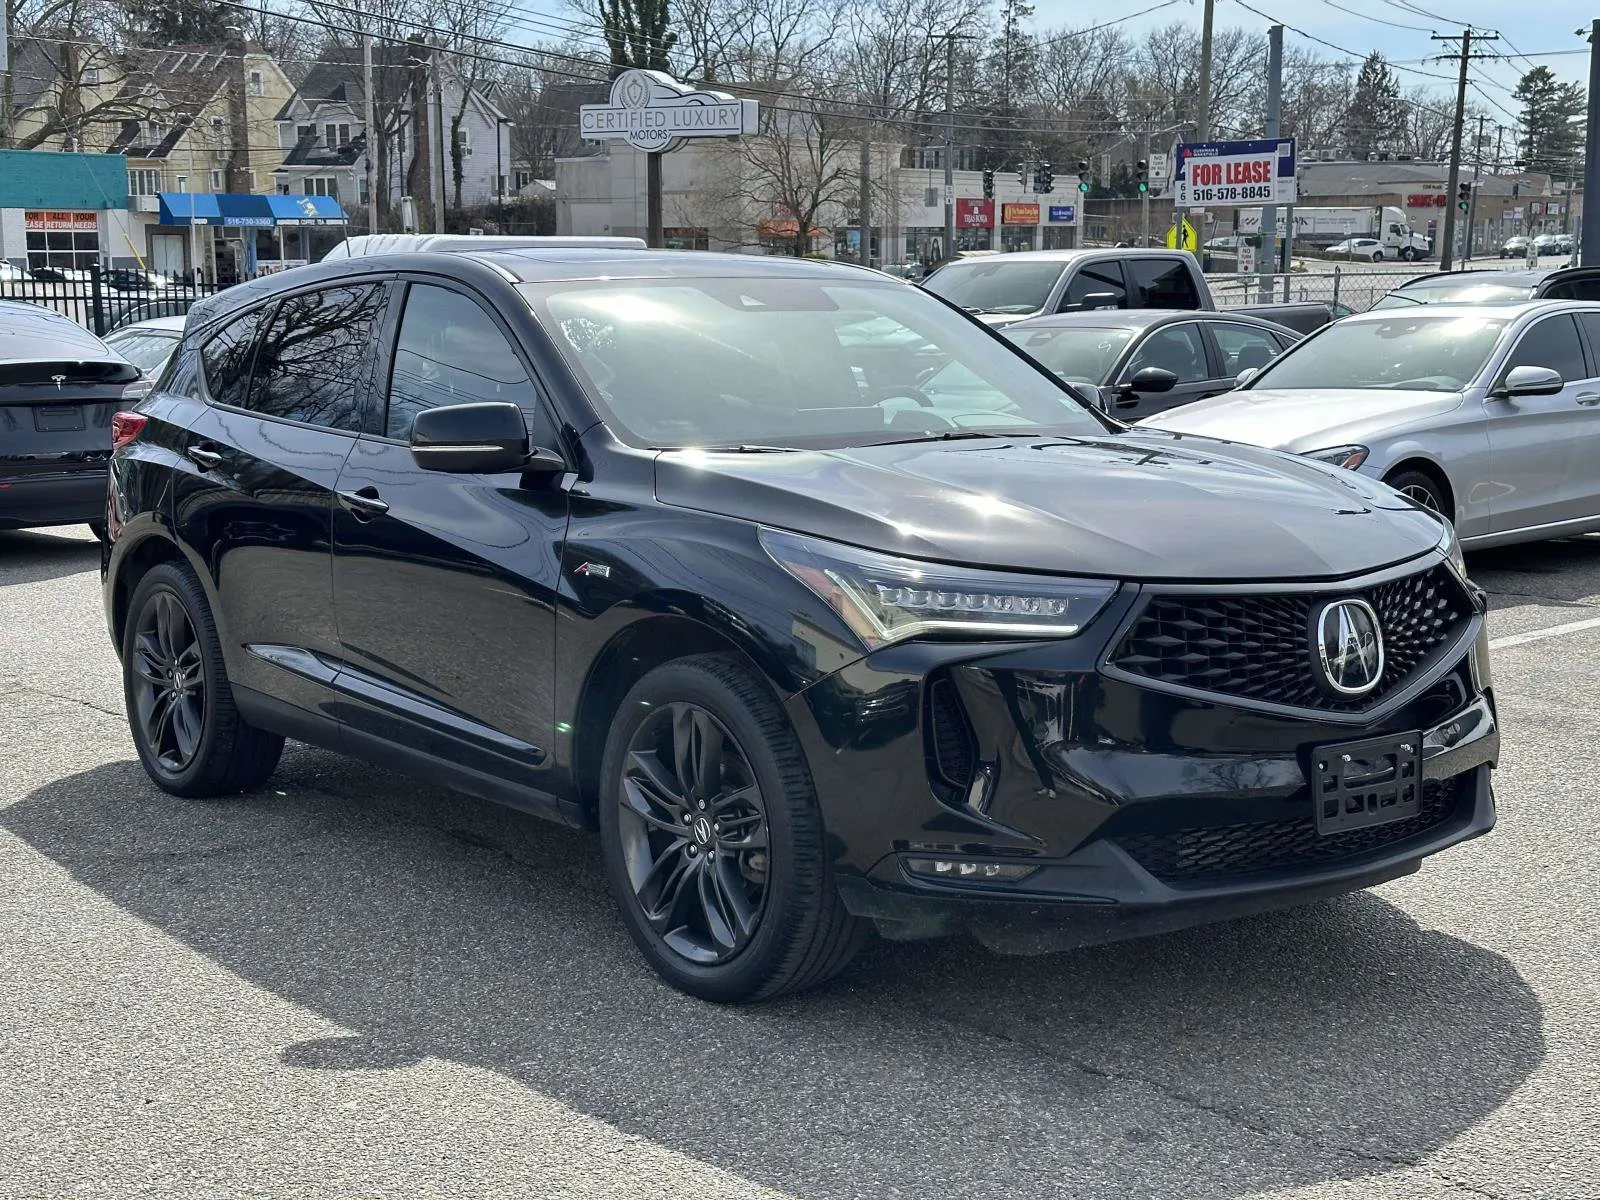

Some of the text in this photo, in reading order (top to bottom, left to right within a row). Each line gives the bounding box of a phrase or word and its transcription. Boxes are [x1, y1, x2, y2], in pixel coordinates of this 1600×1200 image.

[582, 108, 740, 130] CERTIFIED LUXURY
[629, 129, 668, 141] MOTORS
[1192, 163, 1222, 186] FOR
[1226, 160, 1271, 184] LEASE
[1193, 186, 1271, 201] 516-578-8845
[53, 212, 66, 220] ALL
[46, 221, 72, 229] RETURN
[74, 221, 97, 229] NEEDS
